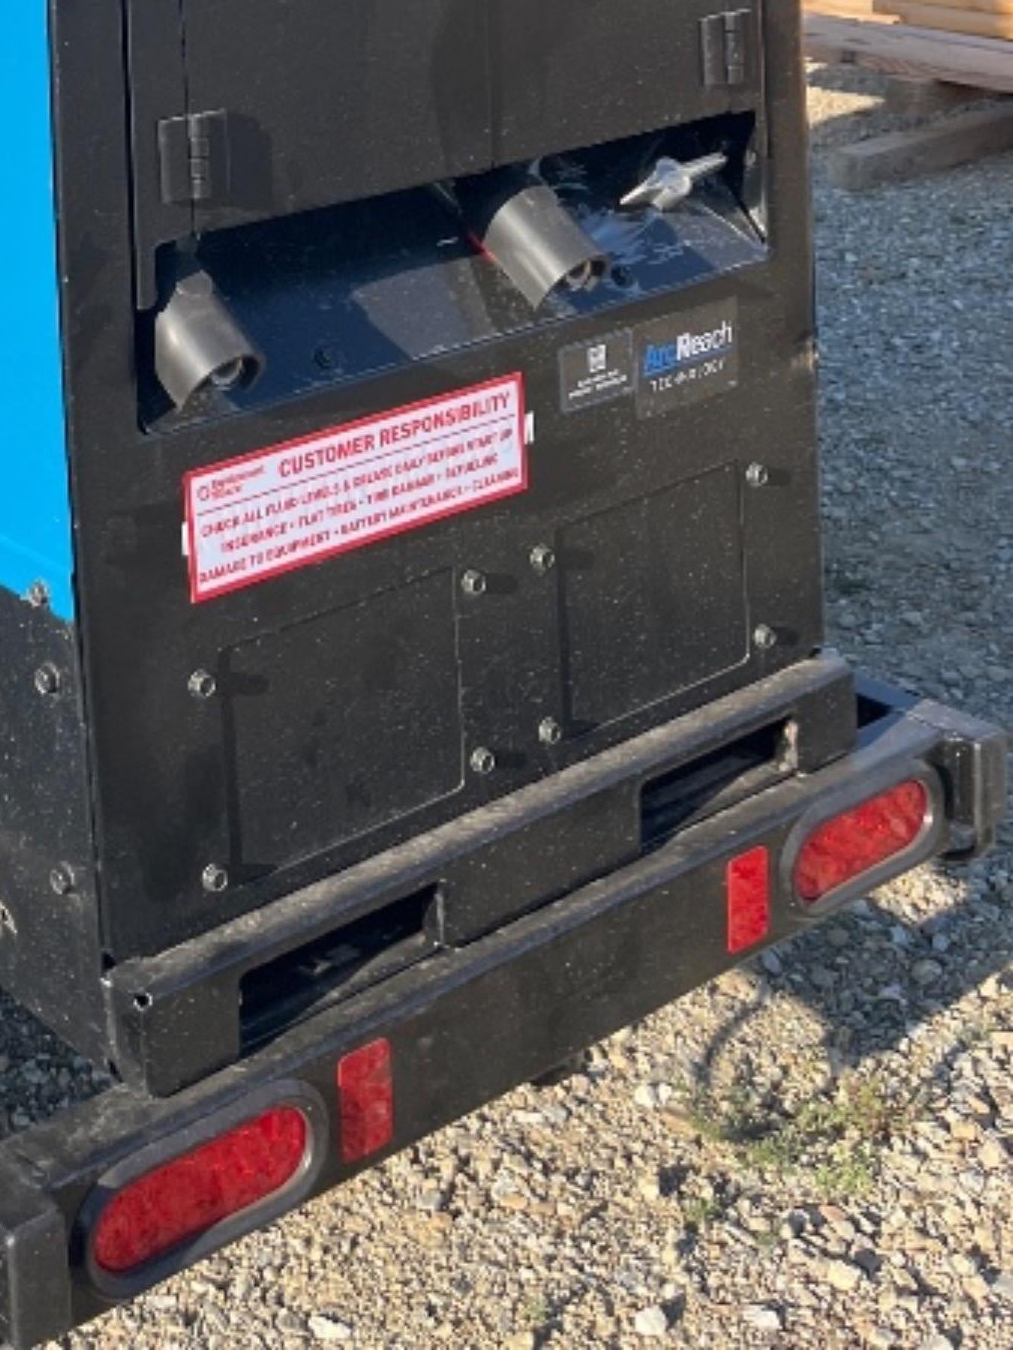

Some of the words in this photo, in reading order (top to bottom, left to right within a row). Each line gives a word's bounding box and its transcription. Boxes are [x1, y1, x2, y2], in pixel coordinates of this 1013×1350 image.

[643, 320, 733, 372] ArcReach
[278, 434, 376, 478] CUSTOMER
[379, 390, 511, 448] RESPONSIBILITY
[200, 514, 239, 538] CHECK
[243, 506, 263, 525] ALL
[199, 557, 247, 583] DAMAGE
[249, 552, 264, 569] TO
[265, 530, 331, 562] EQUIPMENT
